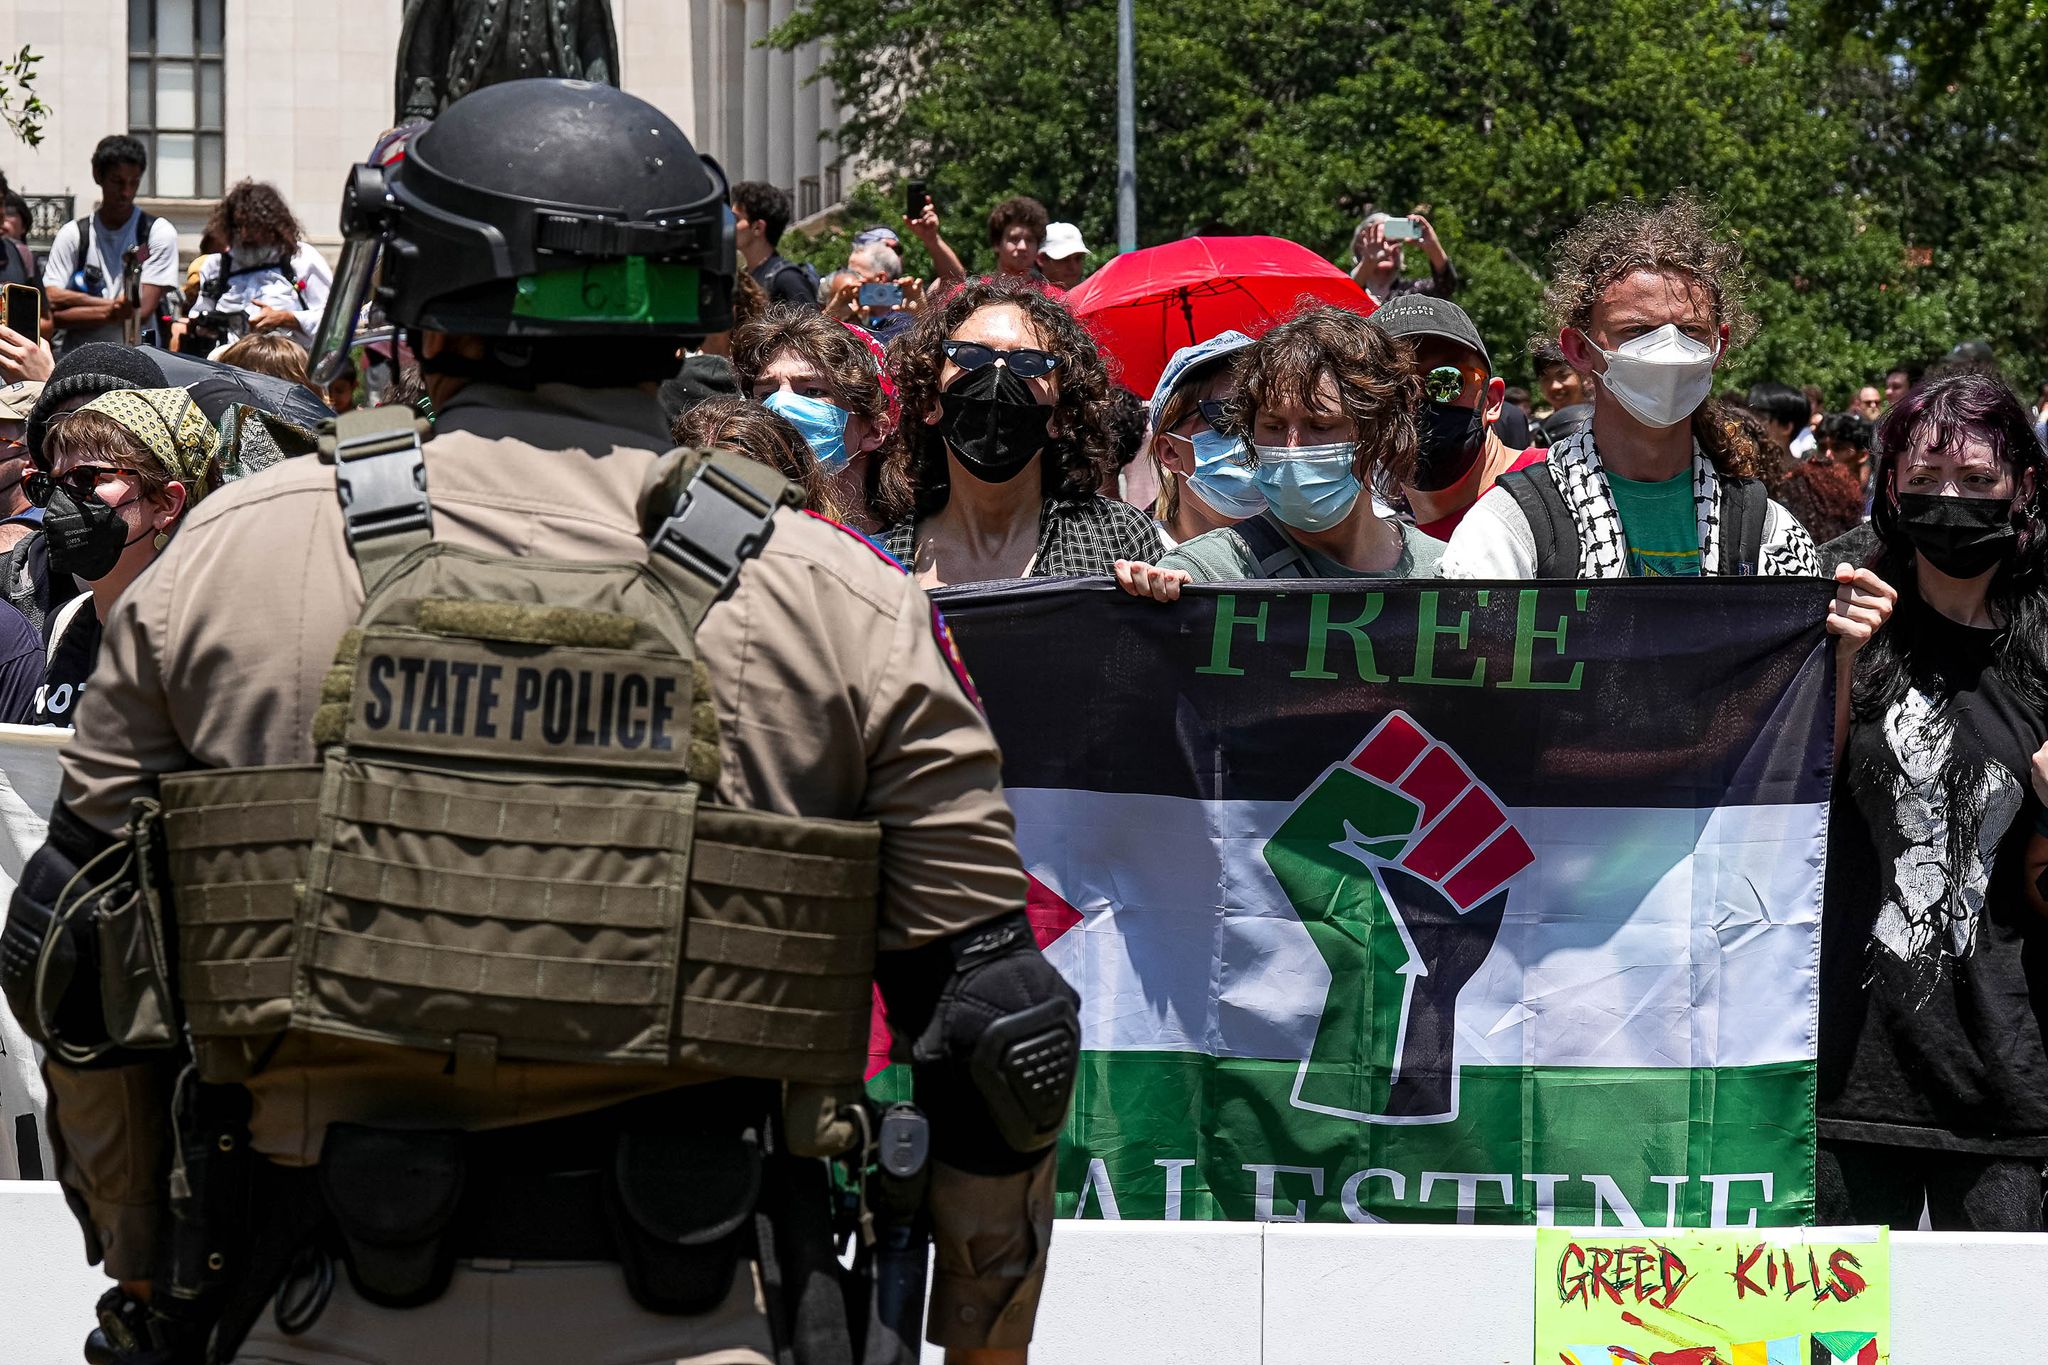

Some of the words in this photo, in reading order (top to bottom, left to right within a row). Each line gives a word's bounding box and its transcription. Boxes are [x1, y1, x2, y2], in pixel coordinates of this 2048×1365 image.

[1195, 589, 1589, 691] FREE
[365, 654, 502, 738] STATE
[511, 667, 676, 750] POLICE
[1073, 1158, 1774, 1228] ALESTINE
[1557, 1239, 1698, 1310] GREED
[1725, 1241, 1870, 1310] KILLS
